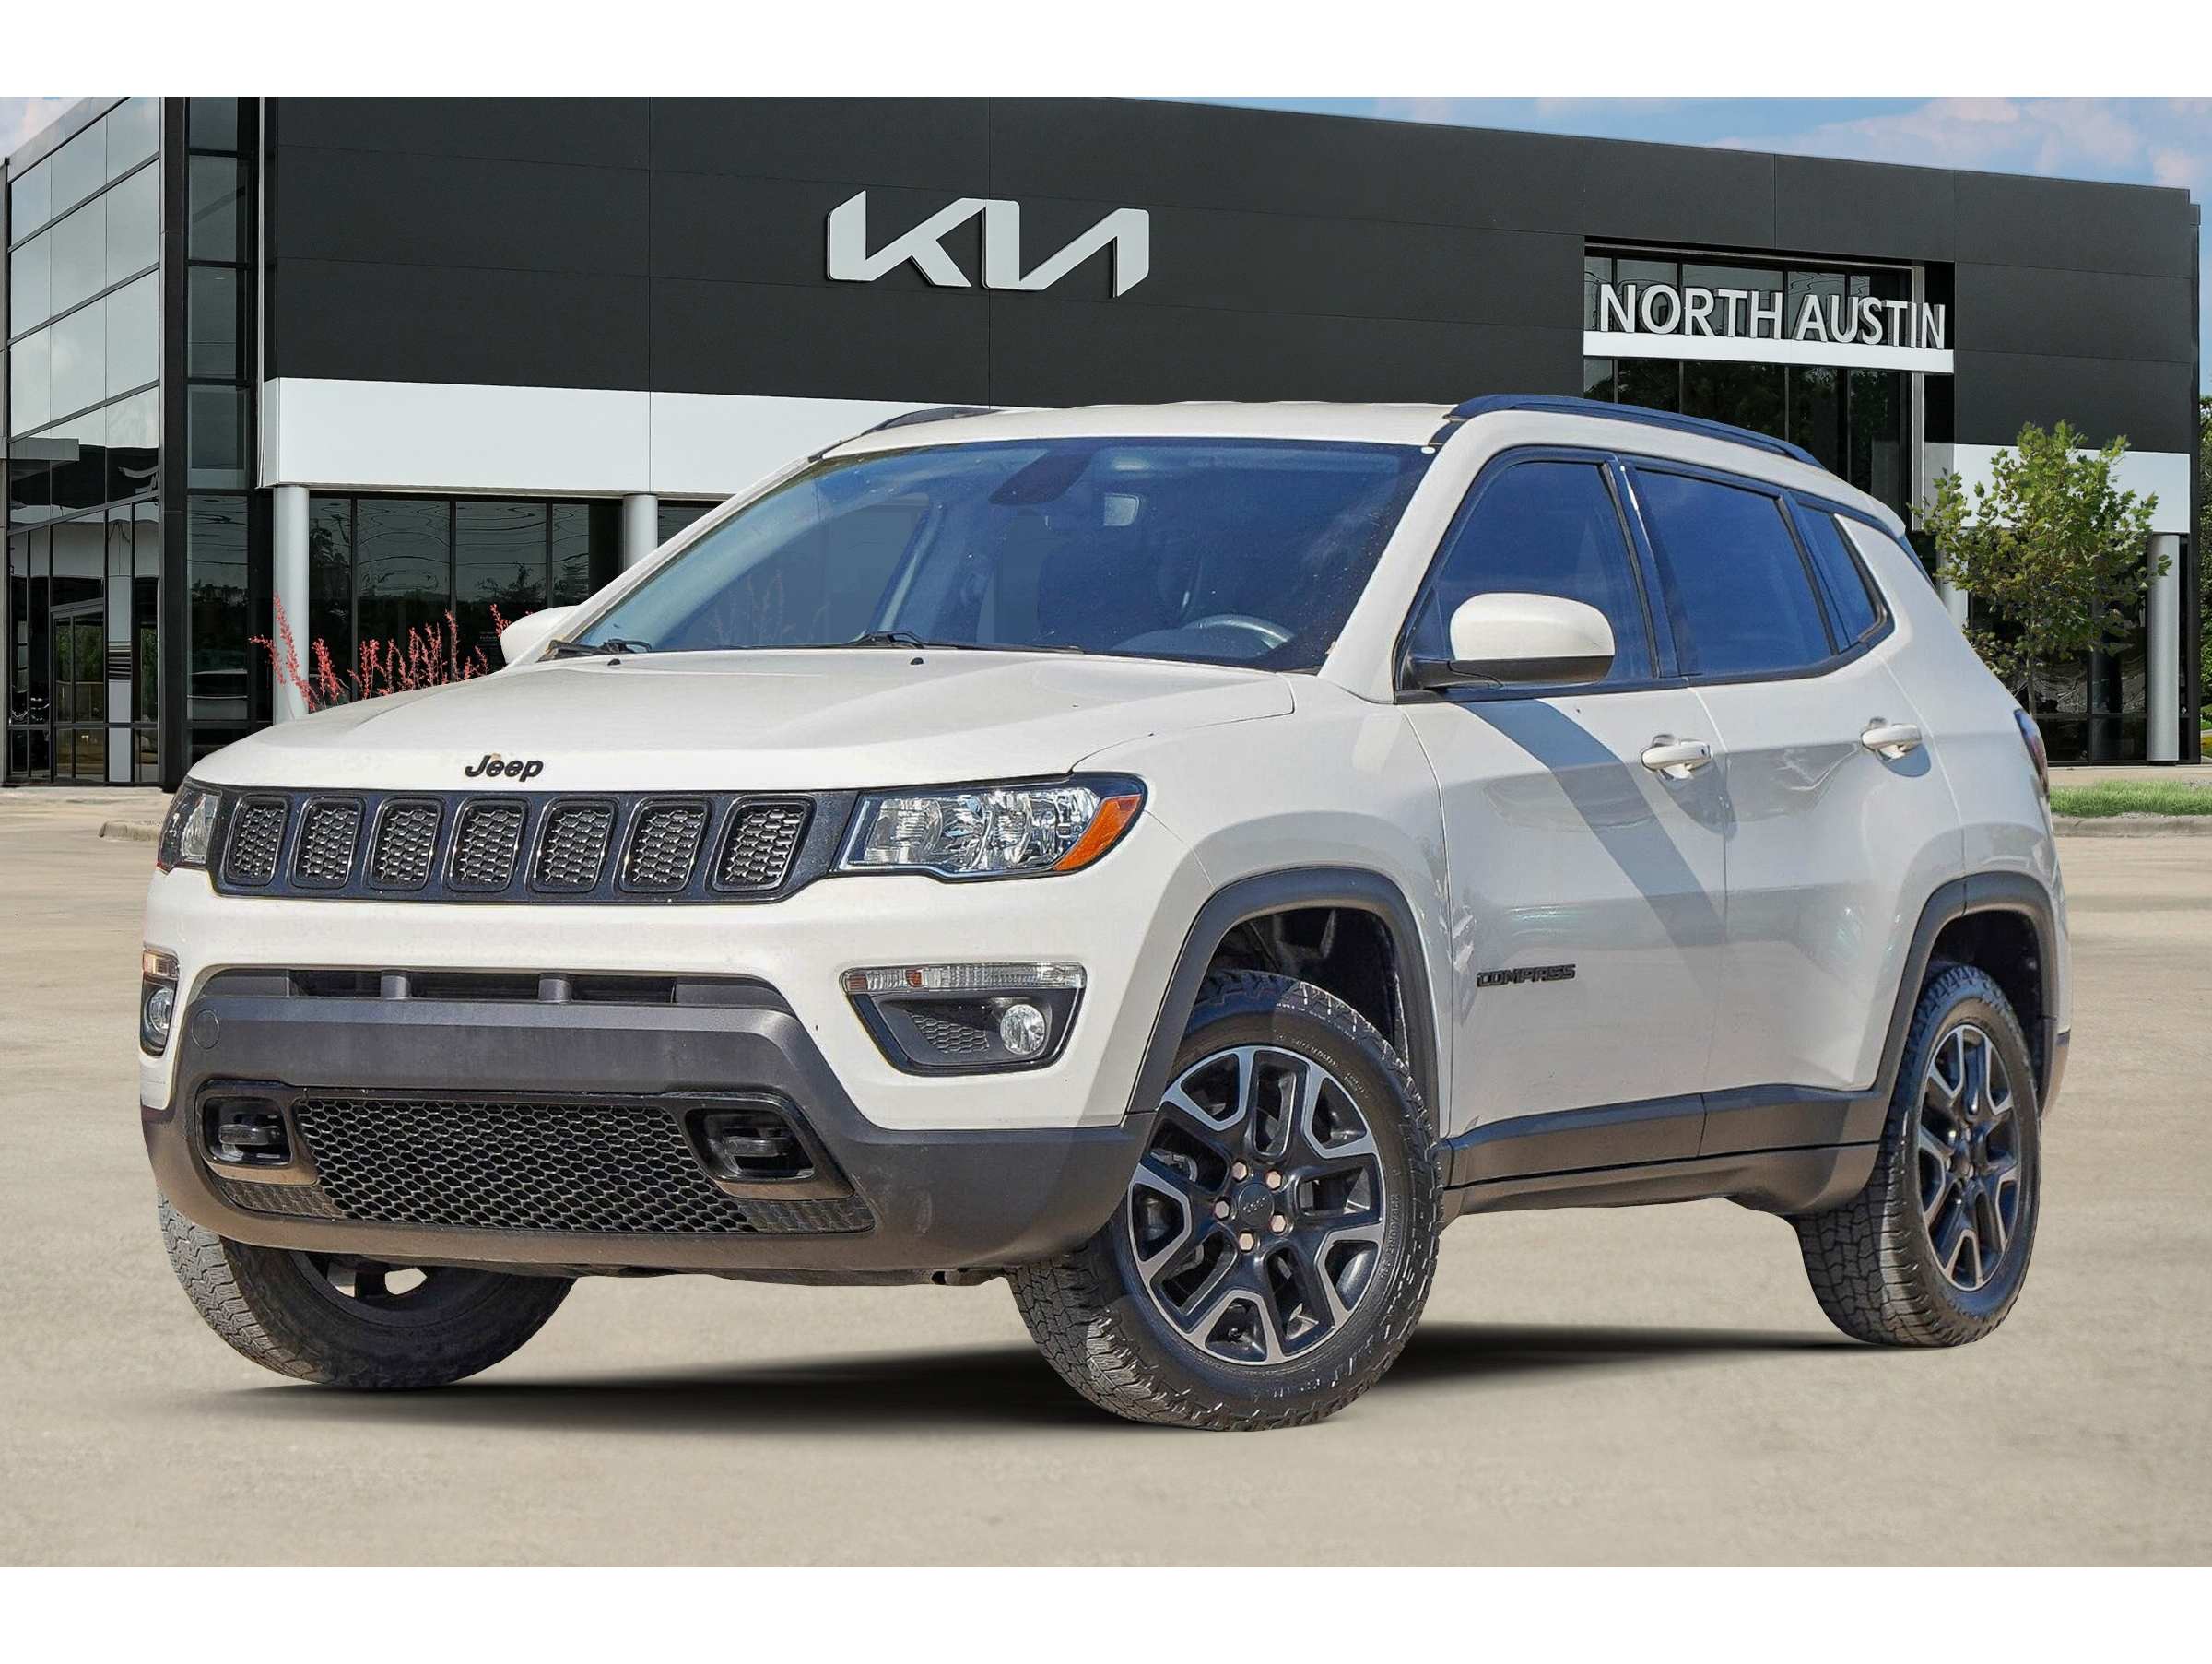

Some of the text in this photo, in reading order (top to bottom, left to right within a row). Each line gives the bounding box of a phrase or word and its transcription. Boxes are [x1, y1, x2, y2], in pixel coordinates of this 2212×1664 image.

[828, 190, 1149, 298] KIA
[1600, 283, 1946, 349] NORTH AUSTIN
[465, 754, 543, 782] Jeep
[1477, 963, 1576, 987] COMPASS
